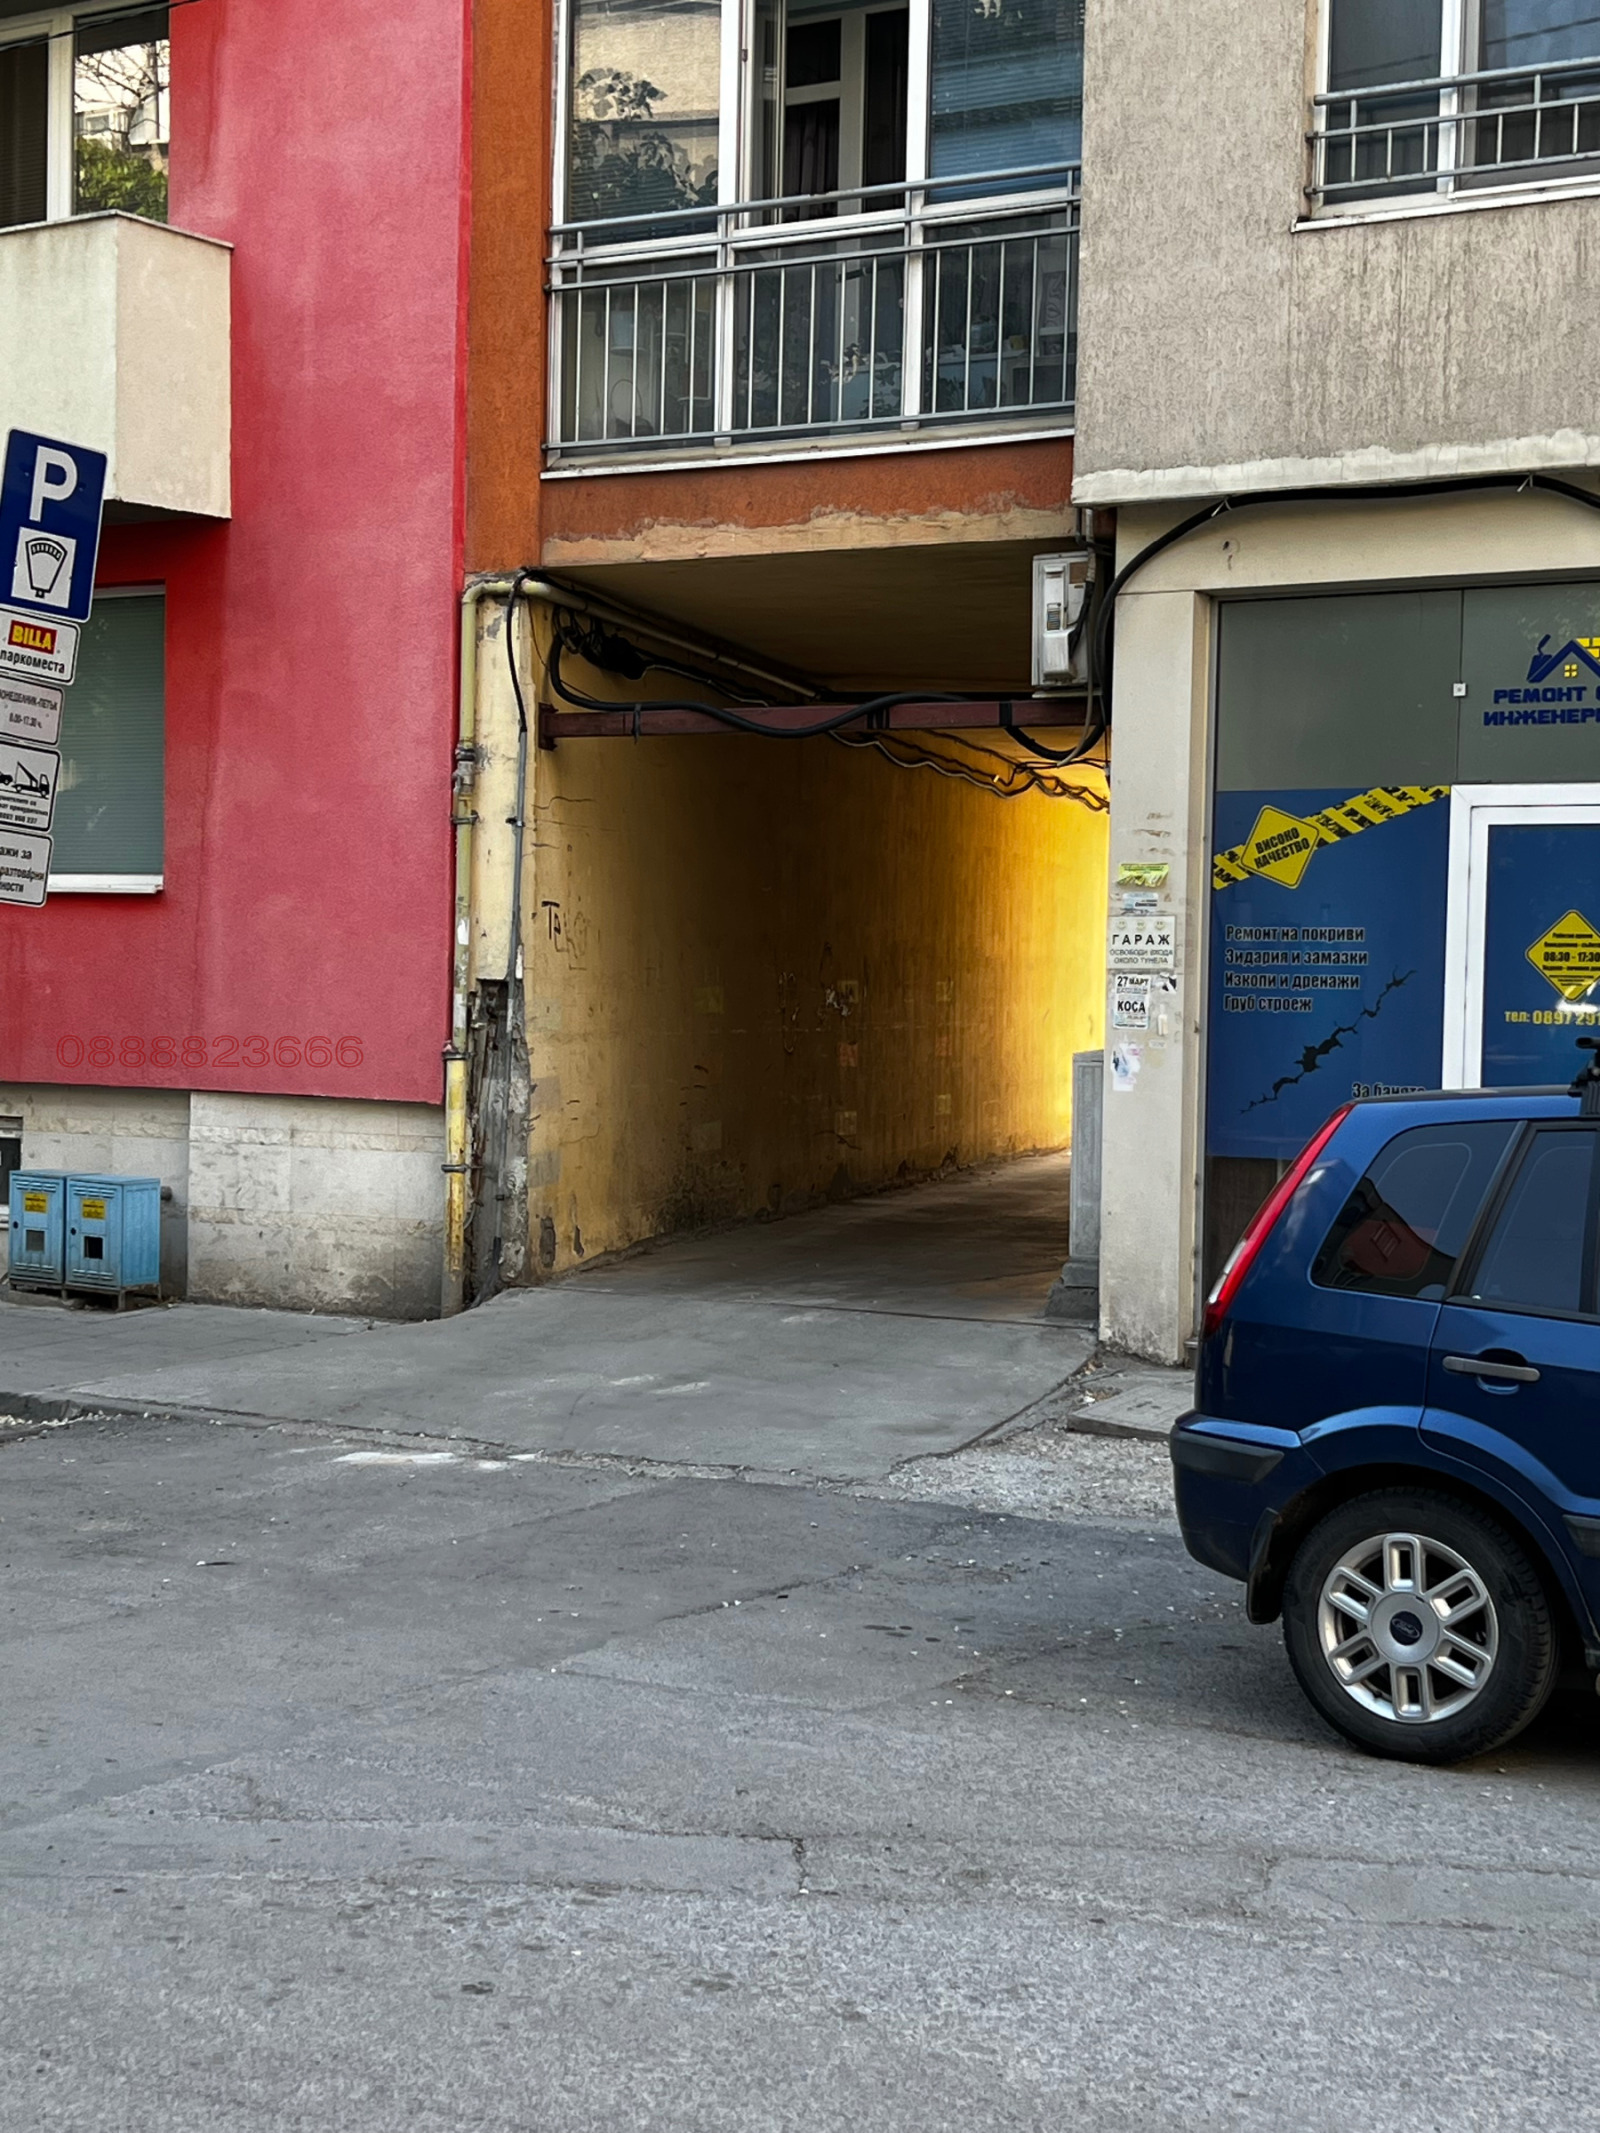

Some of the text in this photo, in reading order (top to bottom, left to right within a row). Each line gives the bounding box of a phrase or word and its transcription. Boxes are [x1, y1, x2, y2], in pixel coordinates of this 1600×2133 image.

[29, 445, 78, 522] P
[11, 624, 52, 650] BILLA
[0, 649, 65, 674] паркоместа
[1493, 686, 1587, 704] РЕМОНТ
[1255, 827, 1300, 855] ВИСОКО
[21, 849, 32, 860] за
[1253, 838, 1311, 869] КАЧЕСТВО
[1112, 934, 1170, 945] ГАРАЖ
[1225, 925, 1365, 943] Ремонт на покриви
[1225, 948, 1369, 967] Зидария и замазки
[1543, 951, 1570, 962] 08:30
[1117, 976, 1128, 987] 27
[1224, 971, 1360, 991] Изкопи и дренажи
[1117, 1001, 1146, 1014] КОСА
[1223, 993, 1313, 1013] Груб строеж
[1504, 1011, 1530, 1022] тел:
[1532, 1010, 1572, 1024] 0897
[1352, 1081, 1370, 1098] За
